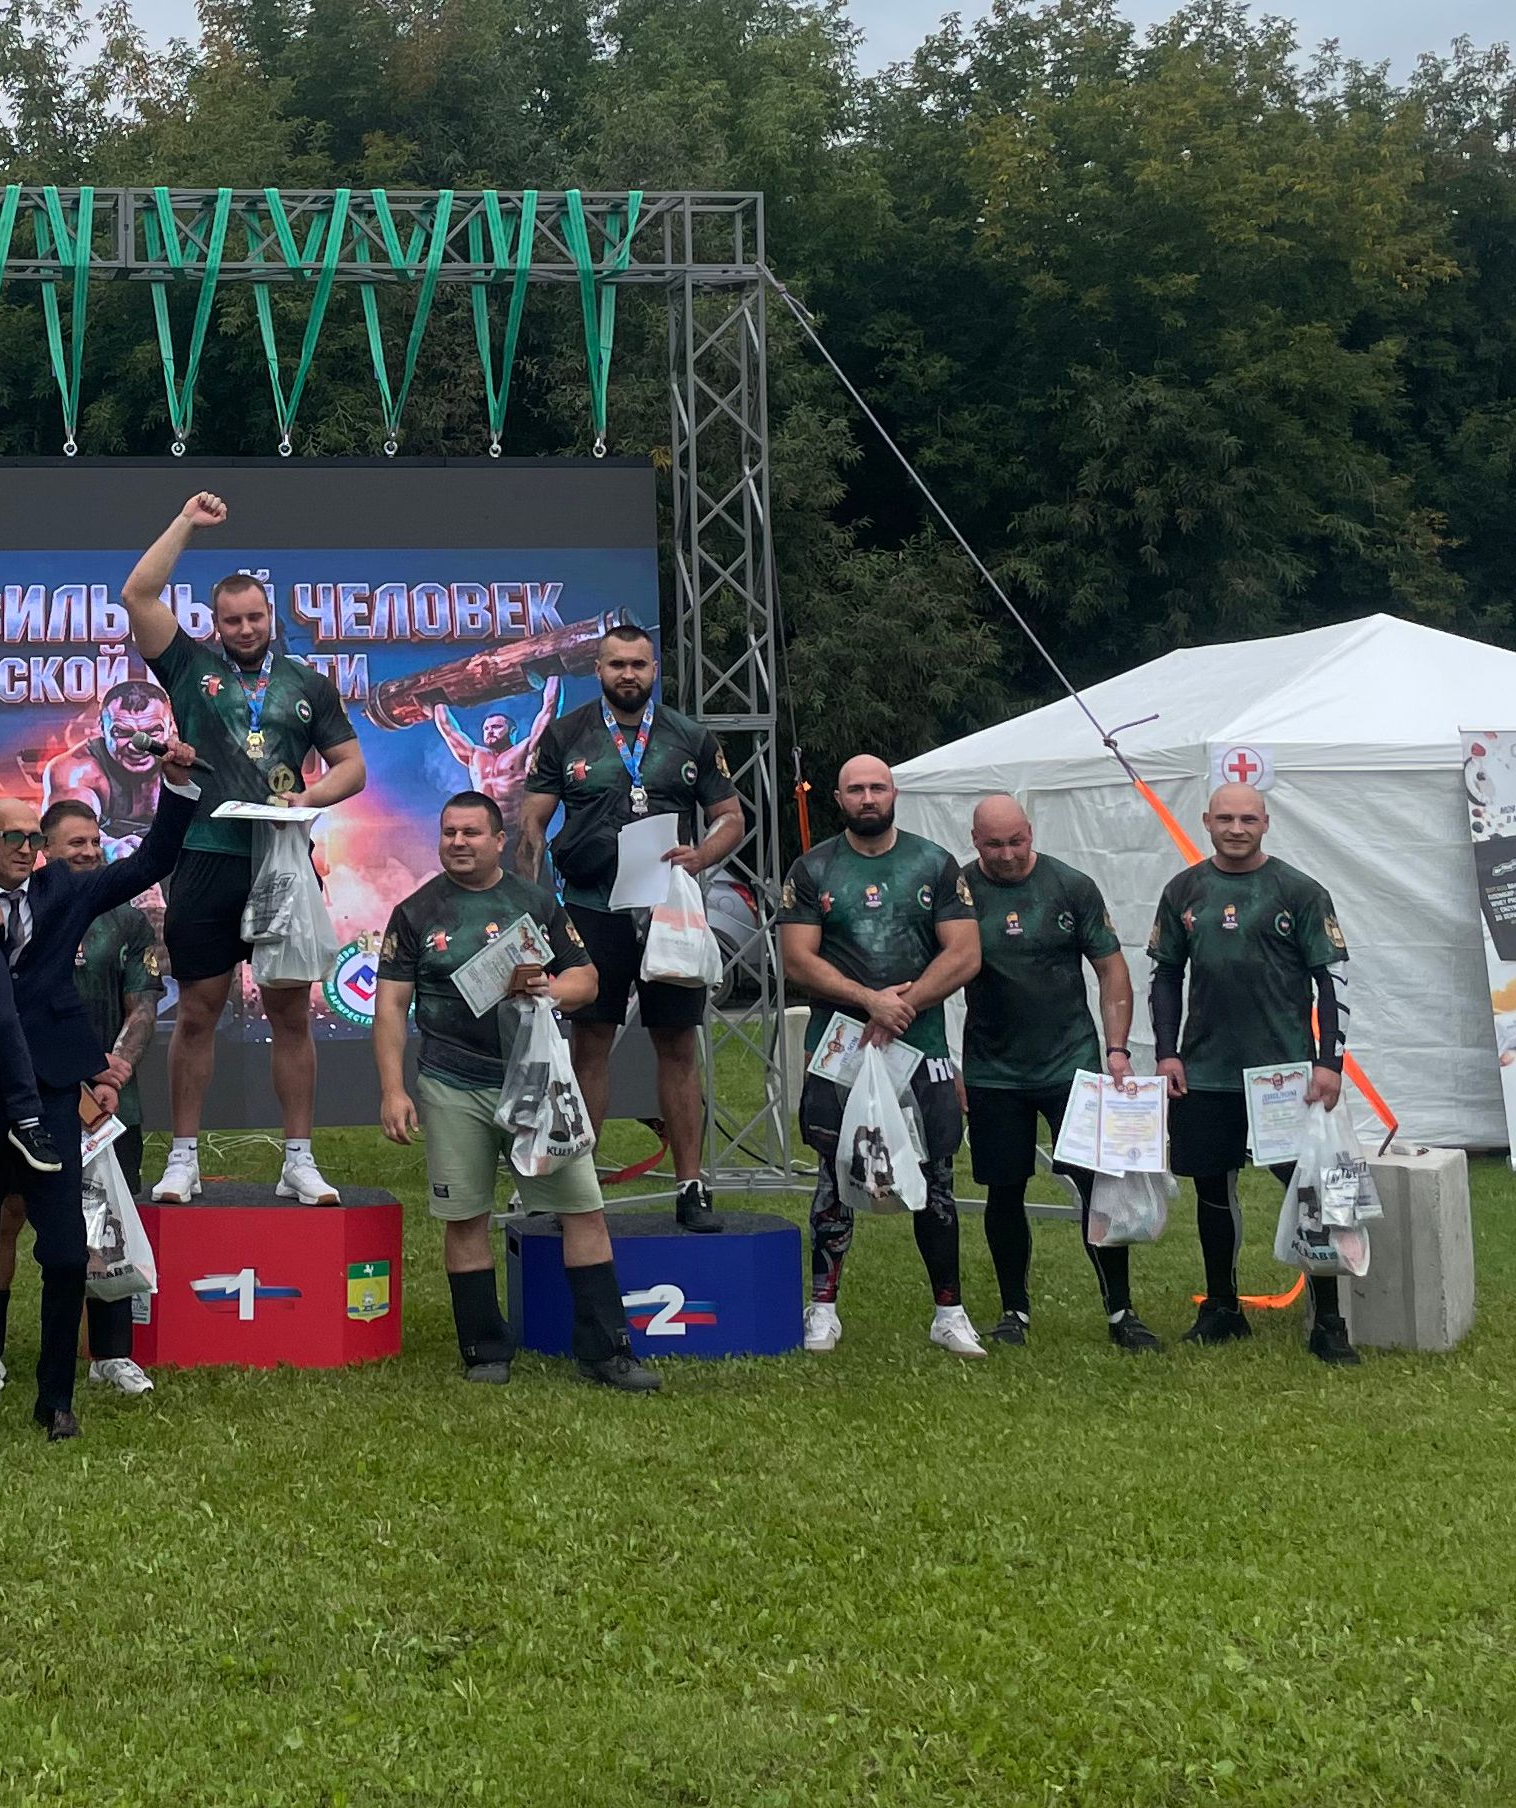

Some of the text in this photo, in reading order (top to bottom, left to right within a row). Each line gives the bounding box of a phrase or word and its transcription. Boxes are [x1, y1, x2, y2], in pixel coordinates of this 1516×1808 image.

[292, 582, 564, 640] ЧЕЛОВЕК
[225, 1268, 255, 1321] 1
[645, 1283, 686, 1336] 2
